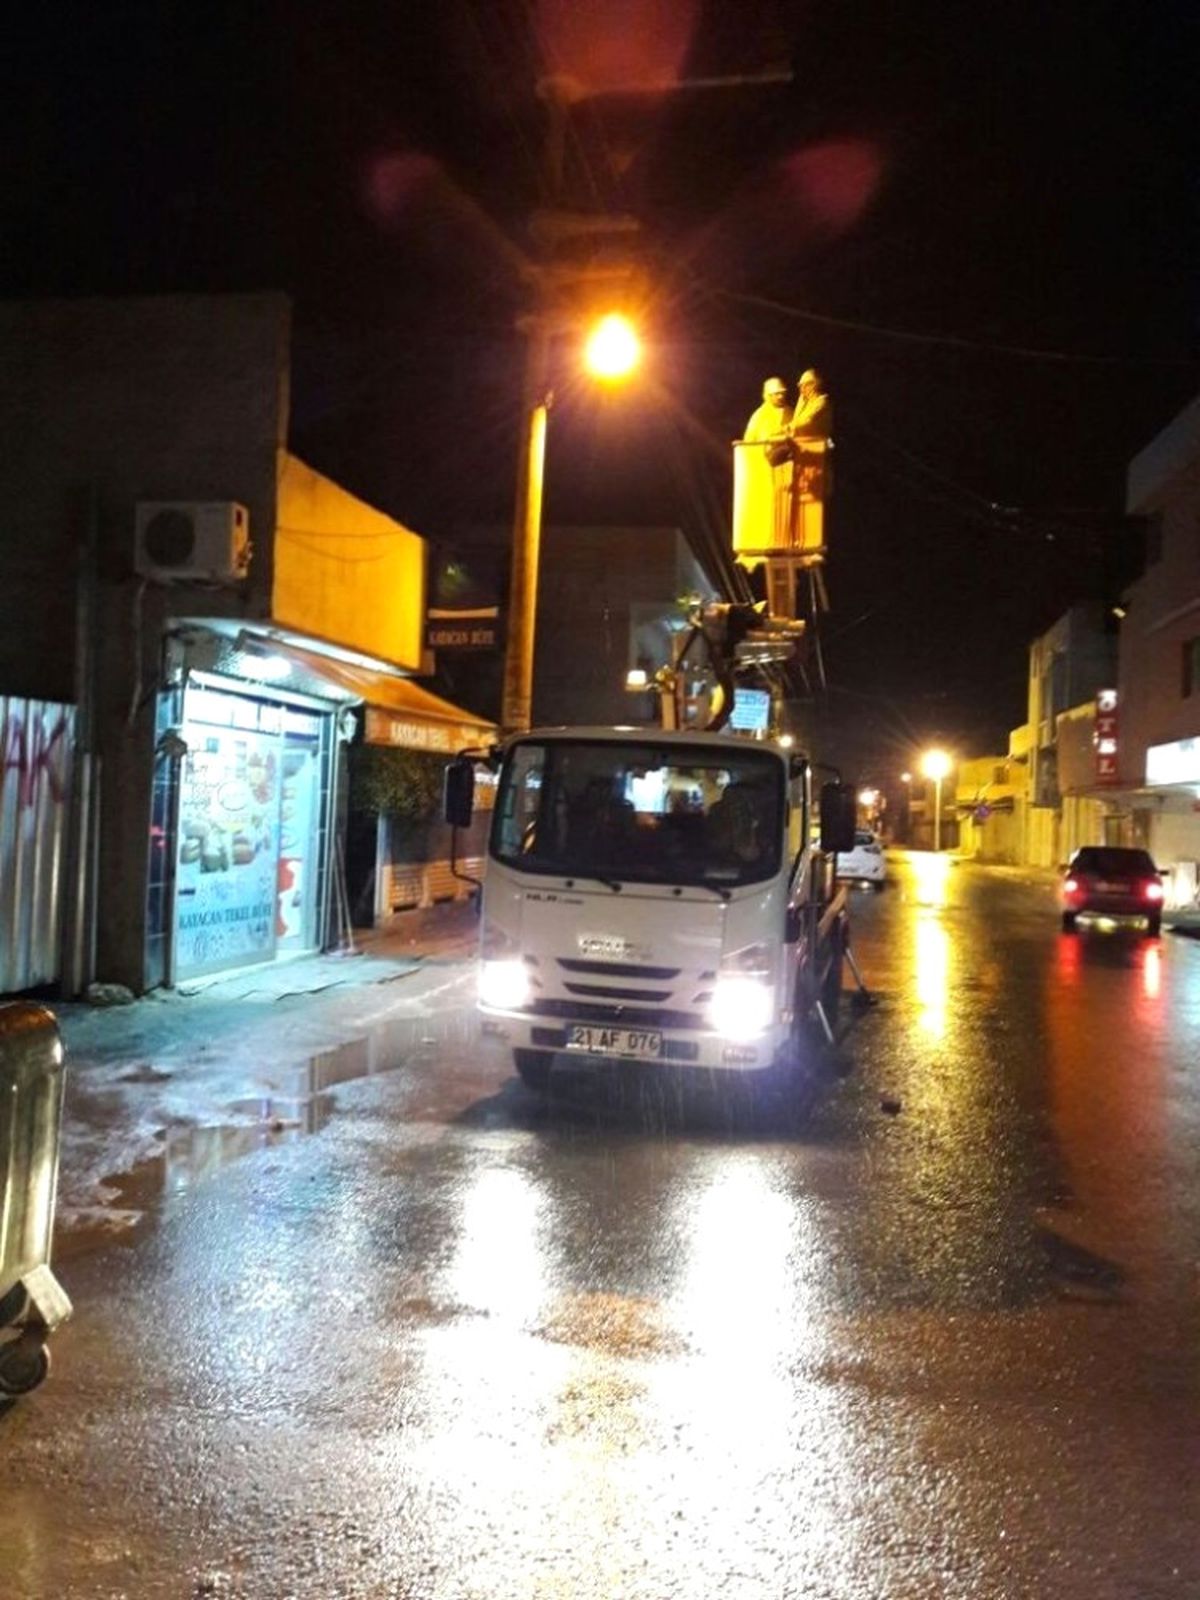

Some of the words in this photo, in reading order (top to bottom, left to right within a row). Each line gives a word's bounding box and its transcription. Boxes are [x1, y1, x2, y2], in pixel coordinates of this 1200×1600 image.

[575, 1027, 592, 1045] 21
[599, 1029, 621, 1047] AF
[628, 1032, 659, 1051] 076
